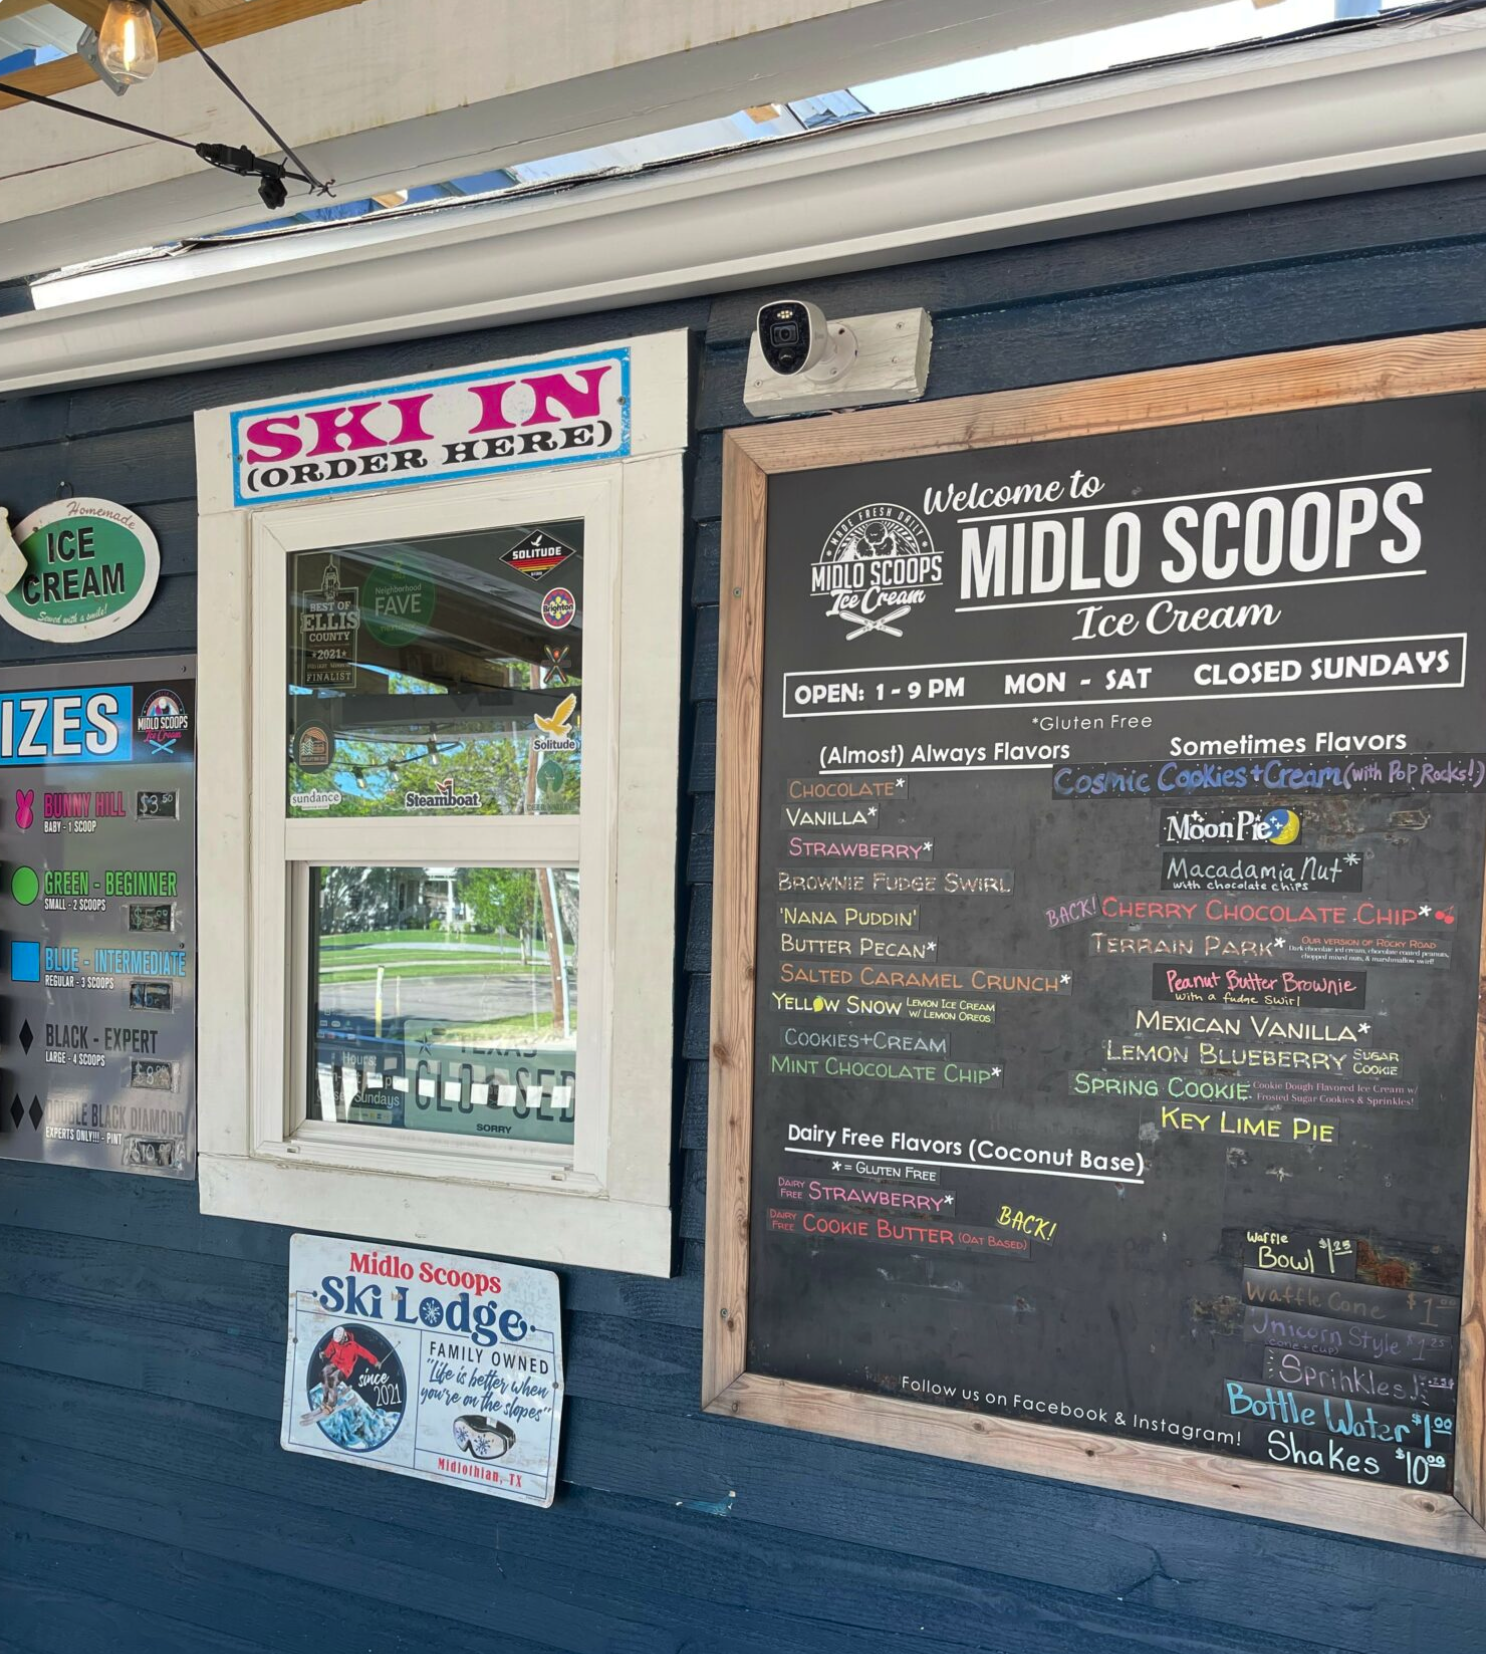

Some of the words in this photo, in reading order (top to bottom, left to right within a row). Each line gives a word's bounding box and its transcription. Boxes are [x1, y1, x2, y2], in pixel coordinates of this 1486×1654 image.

[247, 393, 434, 465] SKI
[468, 365, 613, 435] IN
[247, 448, 428, 492] (ORDER
[442, 420, 613, 465] HERE)
[923, 480, 1065, 516] Welcome
[1069, 469, 1106, 501] to
[66, 501, 136, 530] Homemade
[858, 507, 892, 521] FRESH
[897, 511, 924, 536] DAILY
[47, 526, 95, 564] ICE
[512, 546, 562, 560] SOLITUDE
[960, 511, 1141, 600] MIDLO
[1161, 481, 1424, 584] SCOOPS
[22, 562, 125, 606] CREAM
[812, 562, 865, 592] MIDLO
[870, 555, 942, 586] SCOOPS
[375, 583, 421, 595] Neighborhood
[825, 589, 860, 617] Ice
[861, 586, 926, 614] Cream
[310, 602, 334, 612] BEST
[337, 601, 351, 611] OF
[375, 593, 421, 617] FAVE
[543, 602, 574, 615] Brighton
[302, 611, 359, 632] ELLIS
[1071, 605, 1139, 640] Ice
[1146, 600, 1282, 635] Cream
[309, 632, 350, 642] COUNTY
[317, 649, 341, 660] 2021
[307, 672, 351, 682] FINALIST
[794, 683, 864, 705] OPEN:
[928, 677, 965, 698] PM
[1004, 672, 1066, 695] MON
[1105, 667, 1152, 691] SAT
[1194, 660, 1302, 686] CLOSED
[1310, 649, 1450, 680] SUNDAYS
[138, 717, 160, 730] MIDLO
[160, 715, 188, 729] SCOOPS
[1111, 714, 1153, 729] Free
[534, 739, 575, 750] Solitude
[820, 745, 904, 768] (Almost)
[911, 744, 987, 765] Always
[994, 742, 1070, 761] Flavors
[1169, 735, 1307, 757] Sometimes
[1315, 731, 1407, 754] Flavors
[1053, 765, 1151, 796] Cosmic
[1343, 762, 1382, 789] (with
[1420, 757, 1485, 788] Rocks!)
[44, 792, 91, 818] BUNNY
[95, 791, 126, 818] HILL
[292, 791, 340, 804] sundance
[405, 789, 480, 808] Steamboat
[44, 820, 61, 833] BABY
[74, 820, 97, 833] SCOOP
[44, 871, 89, 896] GREEN
[105, 870, 178, 897] BEGINNER
[1167, 857, 1296, 883] Macadamia
[1173, 880, 1200, 890] with
[1206, 880, 1267, 891] chocolate
[44, 898, 66, 911] SMALL
[80, 899, 106, 912] SCOOPS
[1046, 896, 1097, 927] BACK!
[45, 947, 79, 972] BLUE
[94, 948, 186, 977] INTERMEDIATE
[45, 974, 75, 988] REGULAR
[87, 976, 115, 989] SCOOPS
[1166, 969, 1221, 992] Peanut
[1226, 969, 1278, 991] Butter
[1282, 972, 1357, 995] Brownie
[1175, 993, 1203, 1002] with
[1223, 992, 1259, 1004] fudge
[1264, 995, 1300, 1007] swirl
[46, 1024, 88, 1049] BLACK
[105, 1027, 158, 1054] EXPERT
[45, 1051, 66, 1064] LARGE
[79, 1053, 106, 1067] SCOOPS
[354, 1091, 400, 1109] Sundays
[416, 1060, 575, 1123] CLOSED
[1285, 1082, 1313, 1092] Dough
[1316, 1083, 1355, 1092] Flavored
[1373, 1085, 1404, 1094] Cream
[91, 1103, 126, 1130] BLACK
[131, 1107, 184, 1135] DIAMOND
[476, 1123, 512, 1135] SORRY
[45, 1127, 75, 1141] EXPERTS
[106, 1132, 122, 1146] PINT
[788, 1124, 837, 1148] Dairy
[841, 1127, 885, 1149] Free
[891, 1132, 962, 1156] Flavors
[968, 1139, 1074, 1168] (Coconut
[1080, 1151, 1145, 1177] Base)
[996, 1205, 1058, 1241] BACK!
[1247, 1232, 1288, 1244] Waffle
[1258, 1246, 1315, 1273] Bowl
[350, 1251, 414, 1280] Midlo
[419, 1261, 502, 1297] Scoops
[319, 1275, 382, 1319] Ski
[394, 1286, 528, 1347] Lodge
[1246, 1282, 1321, 1307] Waffle
[1328, 1292, 1386, 1320] Cone
[1348, 1327, 1399, 1358] Style
[429, 1341, 484, 1364] FAMILY
[492, 1352, 549, 1375] OWNED
[358, 1368, 391, 1388] since
[426, 1358, 455, 1384] "Life
[468, 1371, 509, 1396] better
[511, 1379, 548, 1399] when
[373, 1383, 403, 1407] 2021
[420, 1387, 462, 1406] you're
[463, 1395, 479, 1407] on
[480, 1393, 502, 1414] the
[902, 1376, 957, 1397] Follow
[962, 1389, 980, 1402] us
[986, 1391, 1007, 1406] on
[1013, 1394, 1108, 1424] Facebook
[1133, 1413, 1241, 1447] Instagram!
[1227, 1382, 1316, 1425] Bottle
[1324, 1399, 1410, 1443] Water
[1268, 1429, 1380, 1475] Shakes
[437, 1457, 503, 1484] Midlothian,
[508, 1473, 523, 1488] TX
